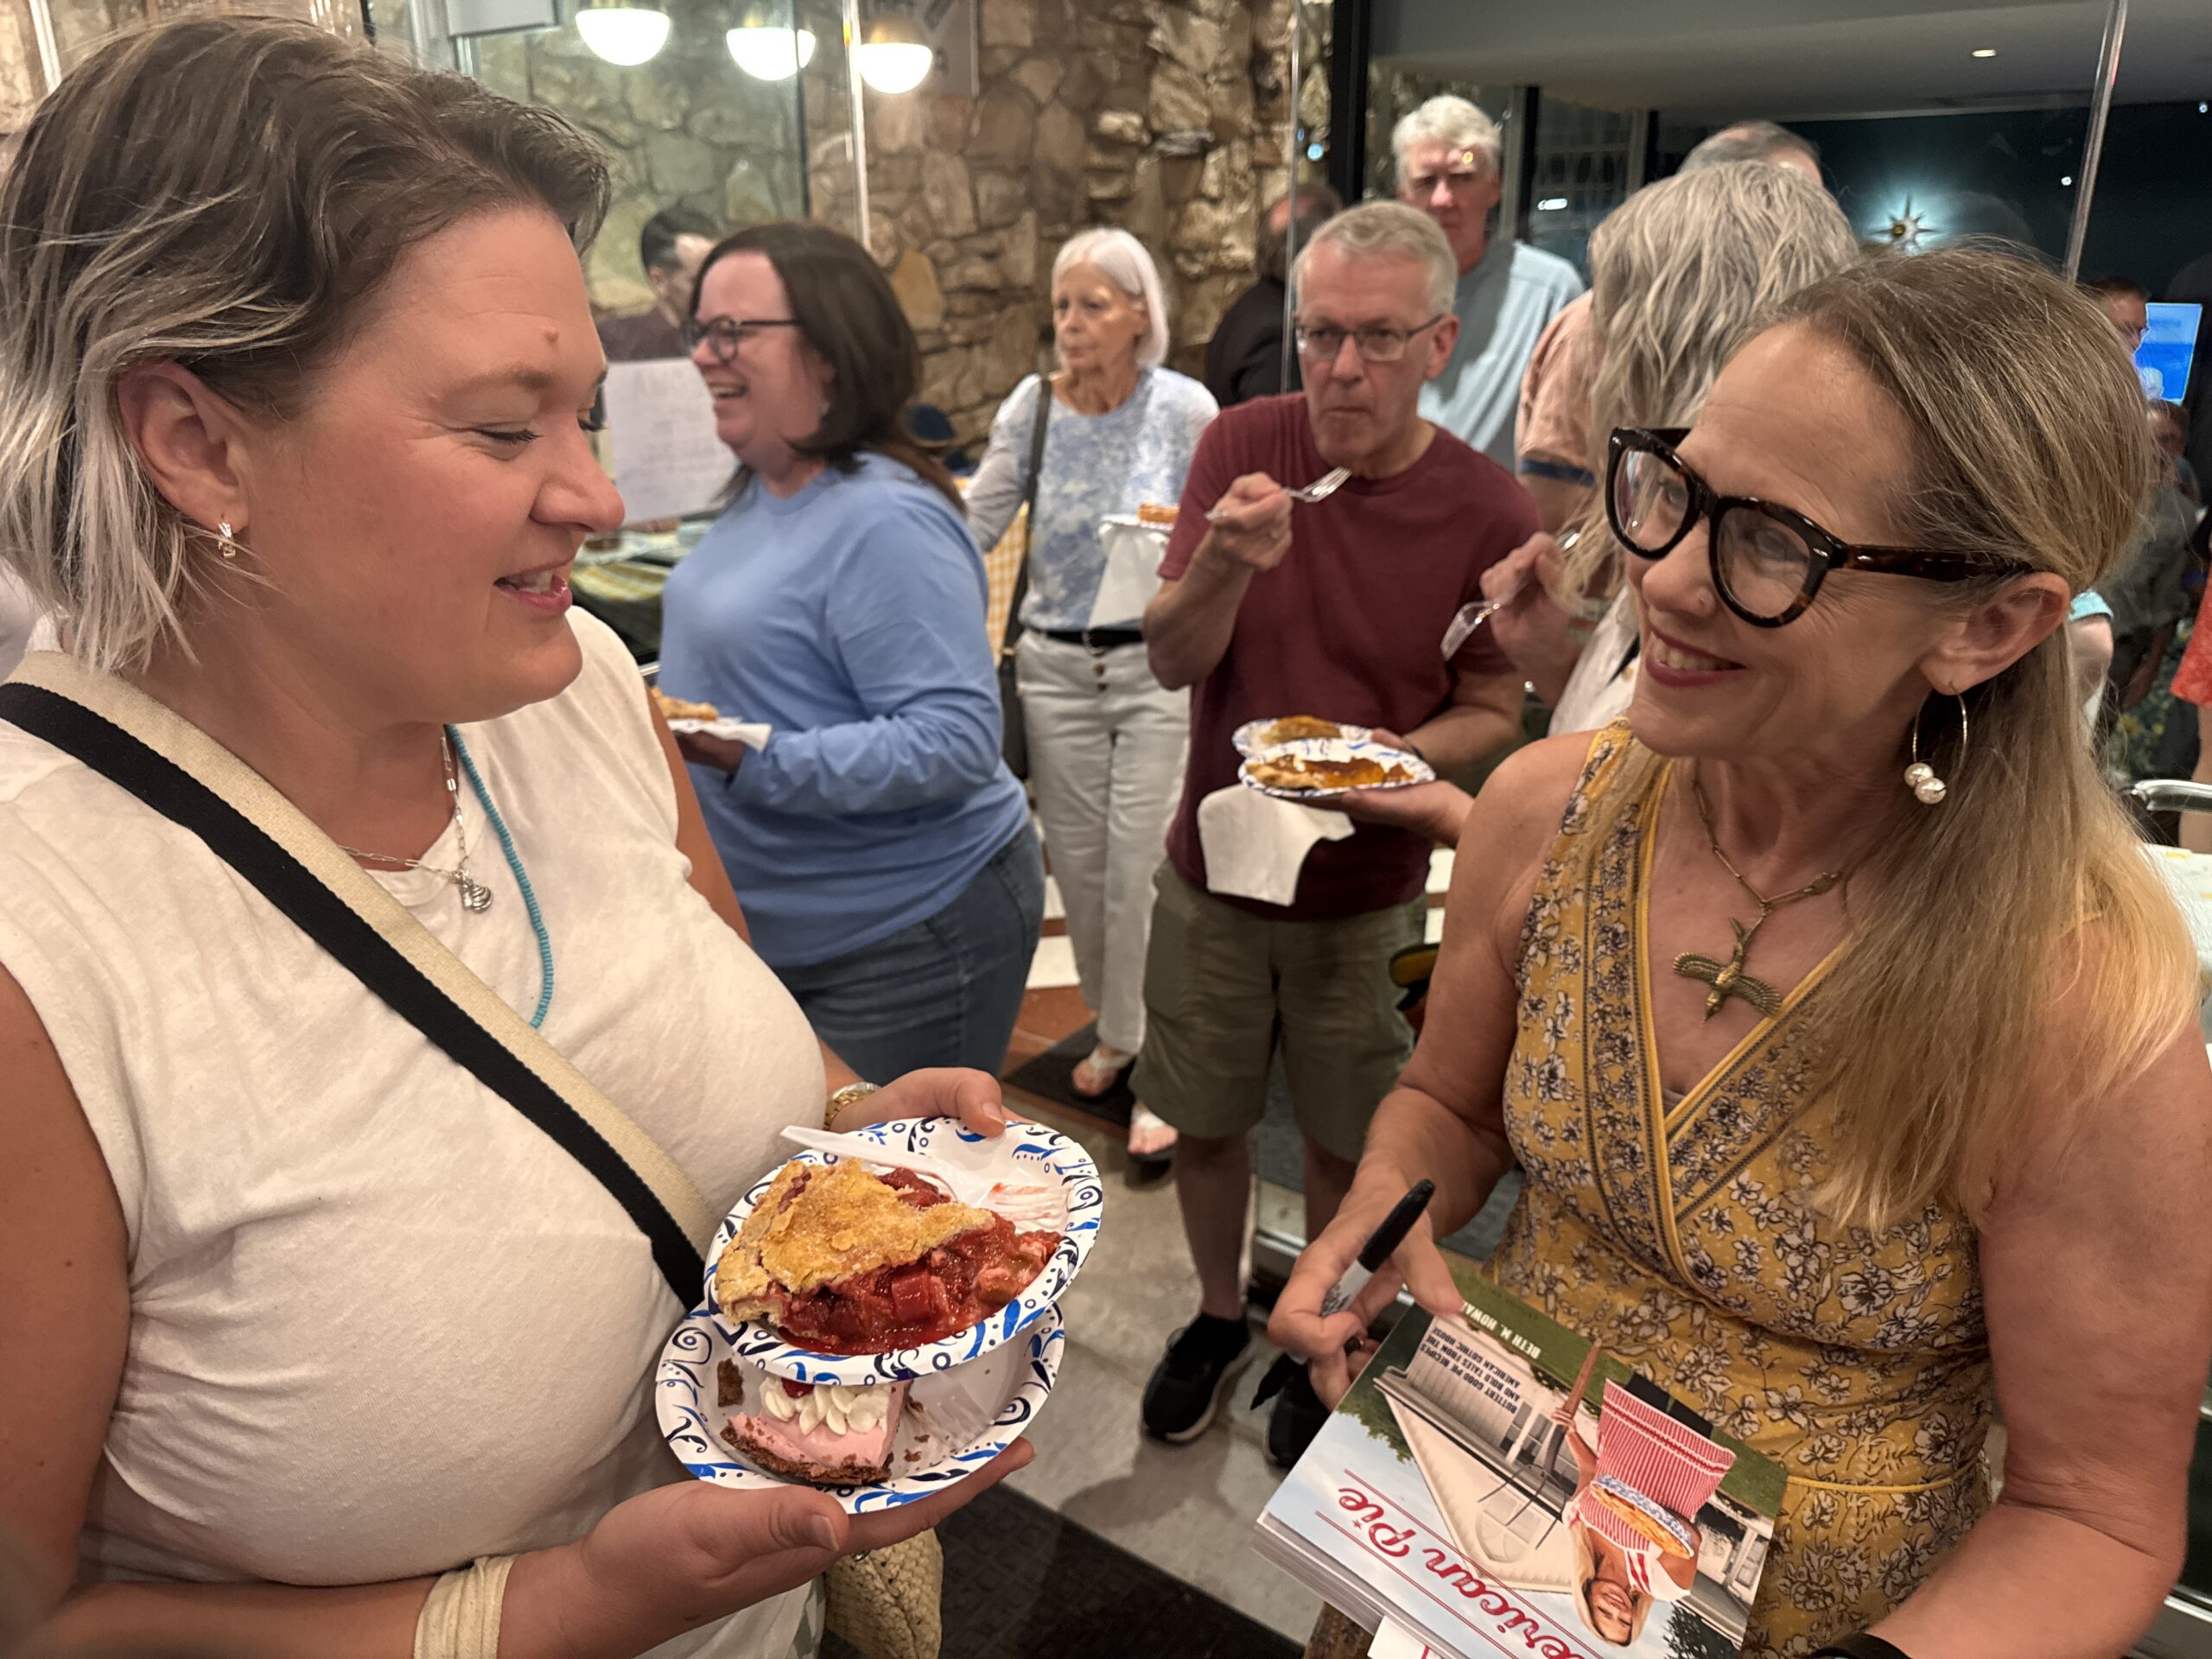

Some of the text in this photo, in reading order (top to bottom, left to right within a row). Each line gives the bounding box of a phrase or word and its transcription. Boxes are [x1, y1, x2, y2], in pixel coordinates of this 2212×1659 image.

[1462, 1300, 1498, 1331] HOWA
[1499, 1324, 1512, 1341] M.
[1511, 1333, 1541, 1359] BETH
[1420, 1343, 1518, 1414] BUTTERY GOOD PIE RECIPES
[1426, 1334, 1521, 1402] AND BOLD TALES FROM THE
[1433, 1326, 1521, 1389] AMERICAN GOTHIC HOUSE
[1338, 1488, 1586, 1659] erican Pie
